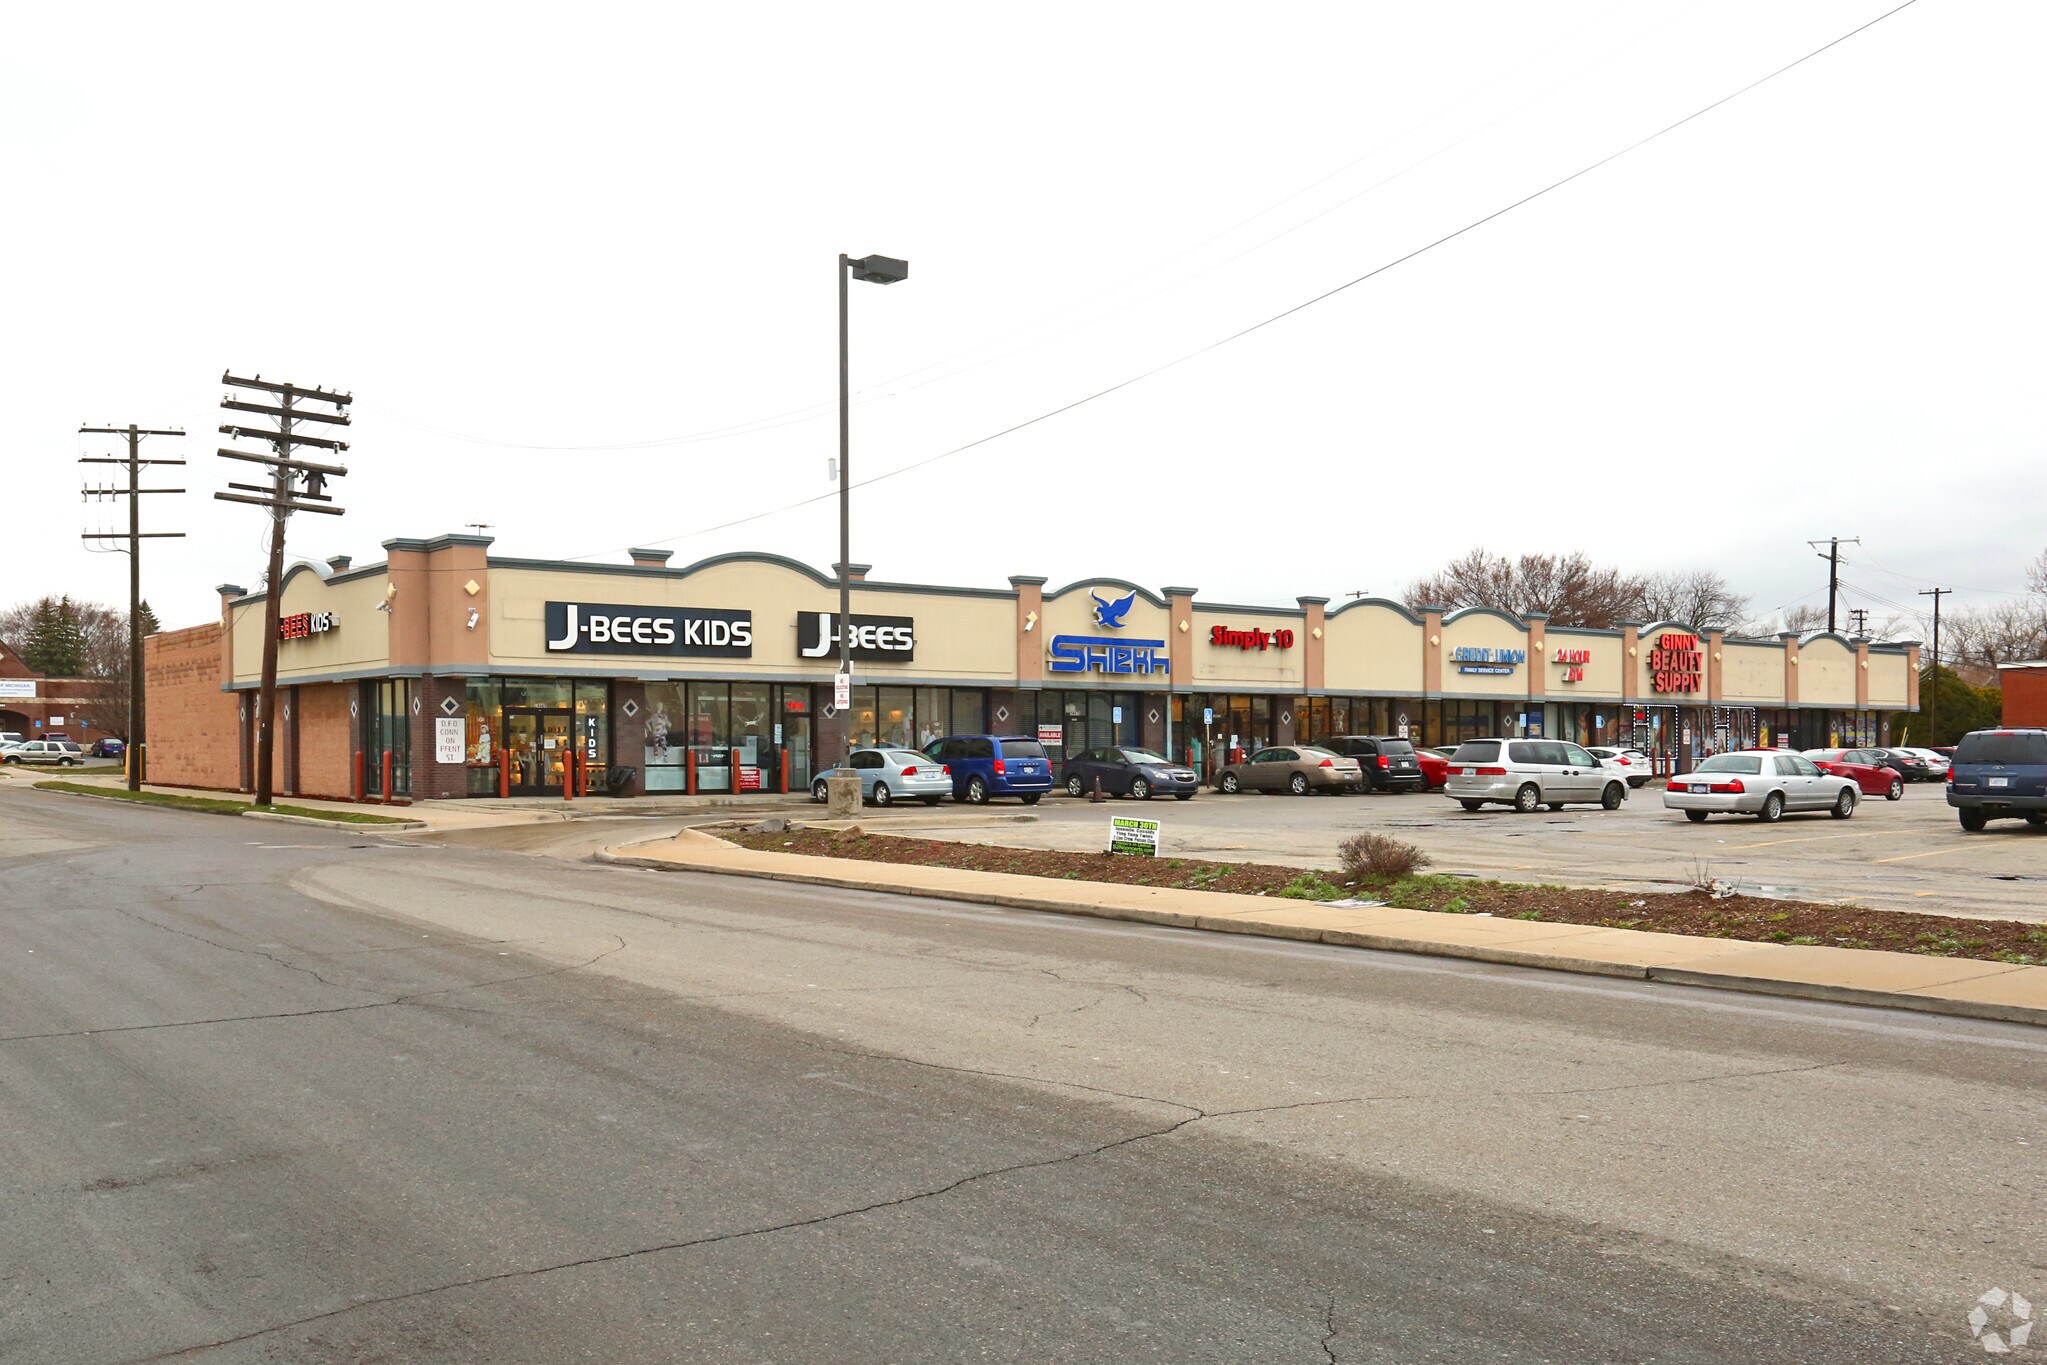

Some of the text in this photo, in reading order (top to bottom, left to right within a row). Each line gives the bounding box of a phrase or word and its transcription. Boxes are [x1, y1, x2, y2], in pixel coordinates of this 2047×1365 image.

[310, 611, 329, 634] KIDS
[548, 604, 753, 650] J-BEES KIDS
[1211, 625, 1294, 651] Simply 10
[1660, 633, 1699, 650] GINNY
[1453, 646, 1525, 664] CREDIT UNION
[1556, 648, 1590, 664] 24 HOUR
[1651, 649, 1703, 672] BEAUTY
[1567, 667, 1583, 682] ATM
[1655, 671, 1703, 693] SUPPLY
[588, 717, 597, 758] KIDS
[1114, 819, 1157, 830] MARCH 30TH
